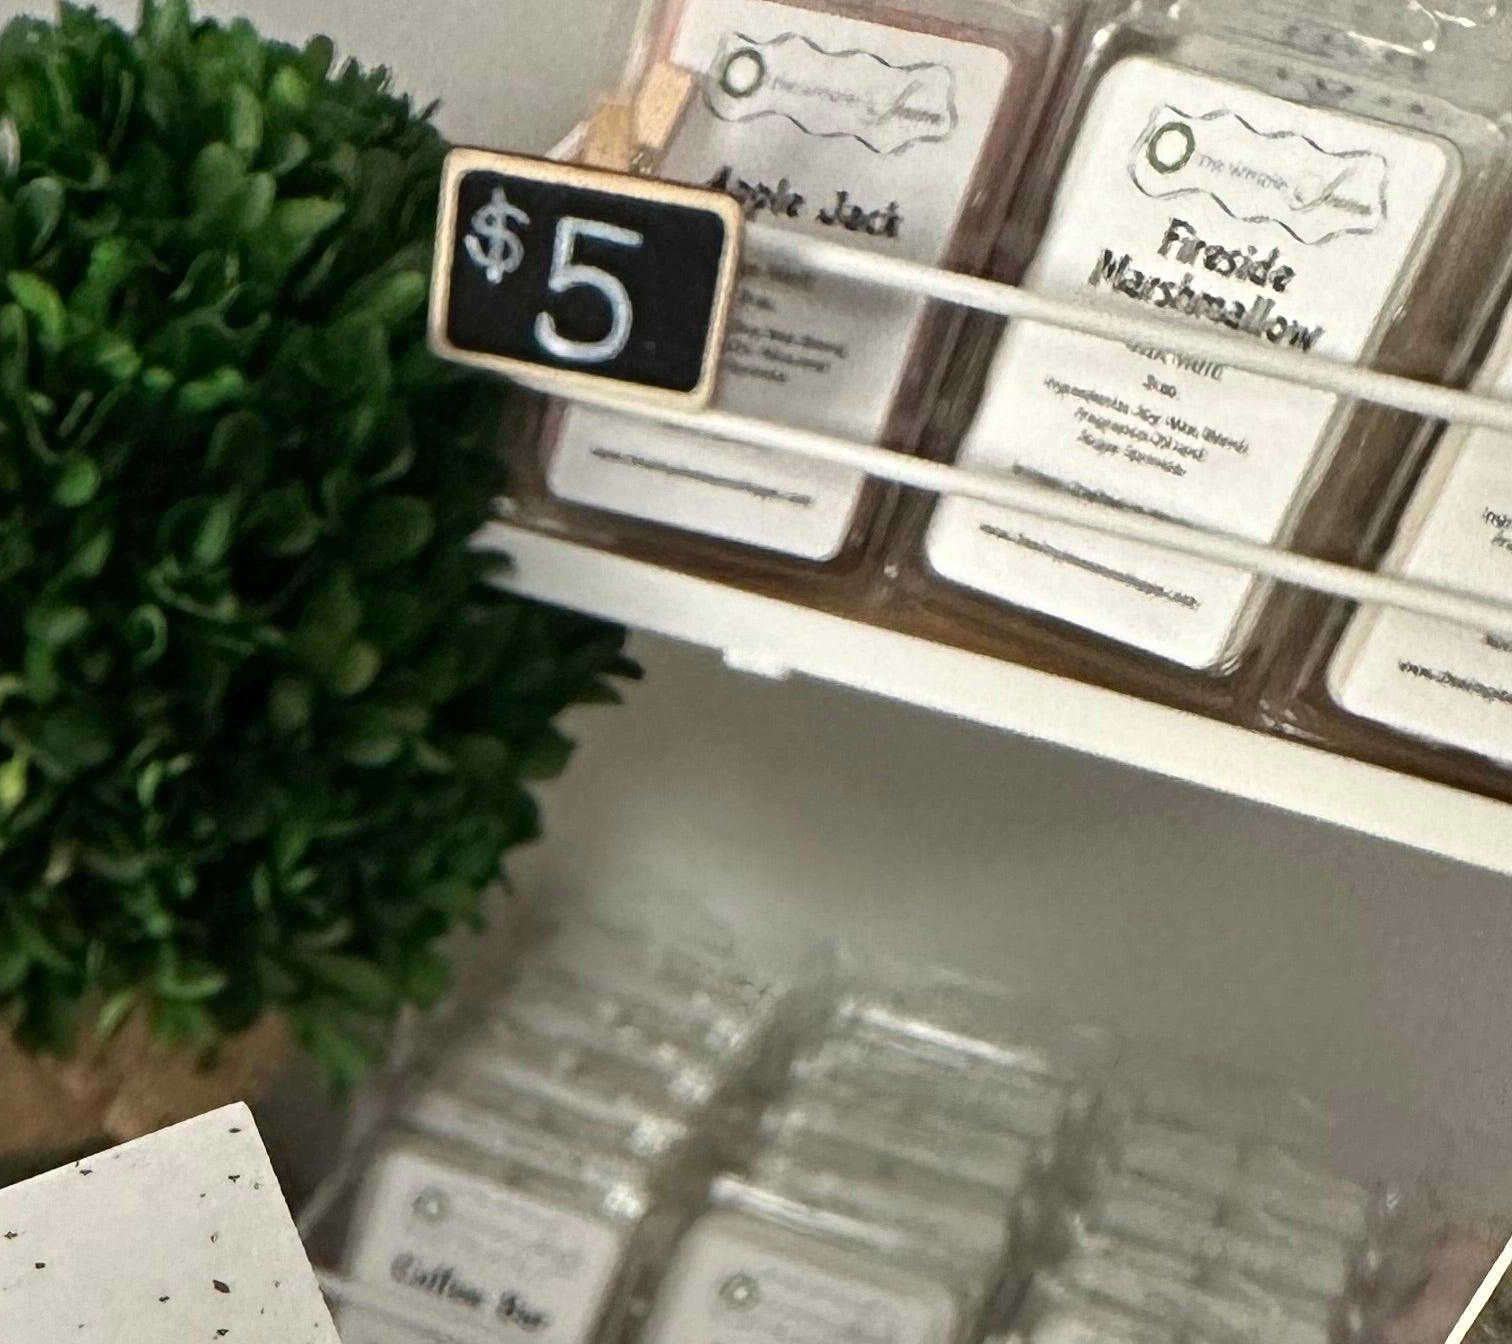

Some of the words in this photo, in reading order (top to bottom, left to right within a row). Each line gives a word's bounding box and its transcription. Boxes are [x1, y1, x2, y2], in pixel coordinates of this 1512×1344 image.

[815, 189, 904, 239] Jack
[1158, 217, 1296, 293] Fireside
[464, 184, 644, 364] $5
[1088, 248, 1326, 351] Marshmallow
